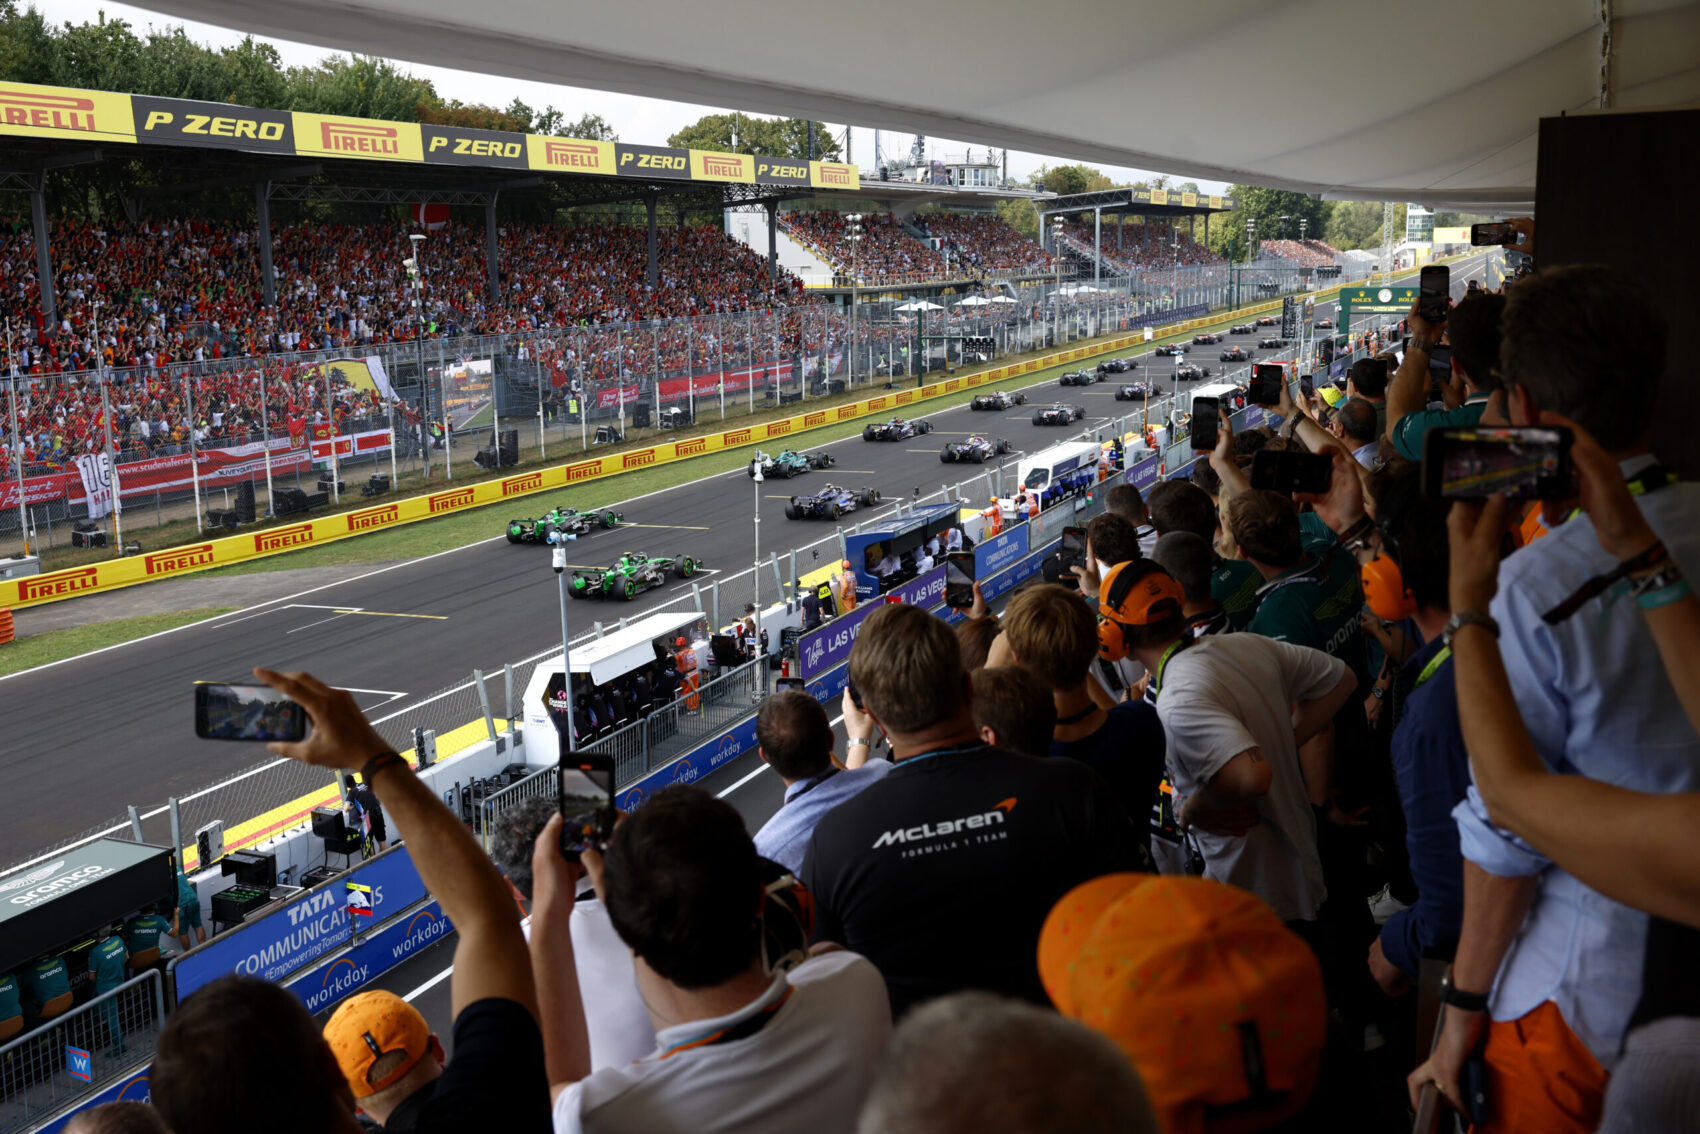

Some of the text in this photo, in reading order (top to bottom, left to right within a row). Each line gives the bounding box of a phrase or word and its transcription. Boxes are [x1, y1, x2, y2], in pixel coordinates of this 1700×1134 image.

[0, 91, 96, 132] RELLI
[144, 111, 285, 141] P ZERO
[320, 122, 399, 154] PIRELLI
[429, 136, 521, 158] P ZERO
[545, 142, 599, 168] PIRELLI
[620, 153, 686, 170] P ZERO
[703, 156, 742, 177] PIRELLI
[758, 164, 807, 179] P ZERO
[820, 166, 850, 185] PIRELLI
[838, 405, 857, 419] PIRELLI
[868, 397, 886, 411] PIRELLI
[767, 420, 791, 437] PIRELLI
[805, 412, 826, 427] PIRELLI
[676, 438, 706, 457] PIRELLI
[724, 429, 751, 446] PIRELLI
[567, 460, 601, 480] PIRELLI
[623, 449, 655, 468] PIRELLI
[502, 473, 541, 496] PIRELLI
[429, 488, 474, 512] PIRELLI
[348, 505, 398, 531] PIRELLI
[255, 525, 312, 552] PIRELLI
[145, 545, 213, 574] PIRELLI
[18, 568, 97, 600] PIRELLI
[911, 587, 927, 605] LAS
[927, 575, 947, 596] VEGA
[828, 630, 848, 653] LAS
[710, 741, 740, 766] workday
[872, 810, 1004, 849] McLaren
[901, 831, 1008, 859] FORMULA 1 TEAM
[11, 865, 102, 904] aramco
[287, 889, 335, 926] TATA
[235, 886, 384, 976] COMMUNICATS
[393, 918, 446, 959] workday
[106, 947, 124, 960] aramco
[264, 920, 360, 980] #EmpoweringTomorrw
[39, 966, 63, 980] aramco
[306, 964, 369, 1010] workday
[74, 1056, 87, 1071] W
